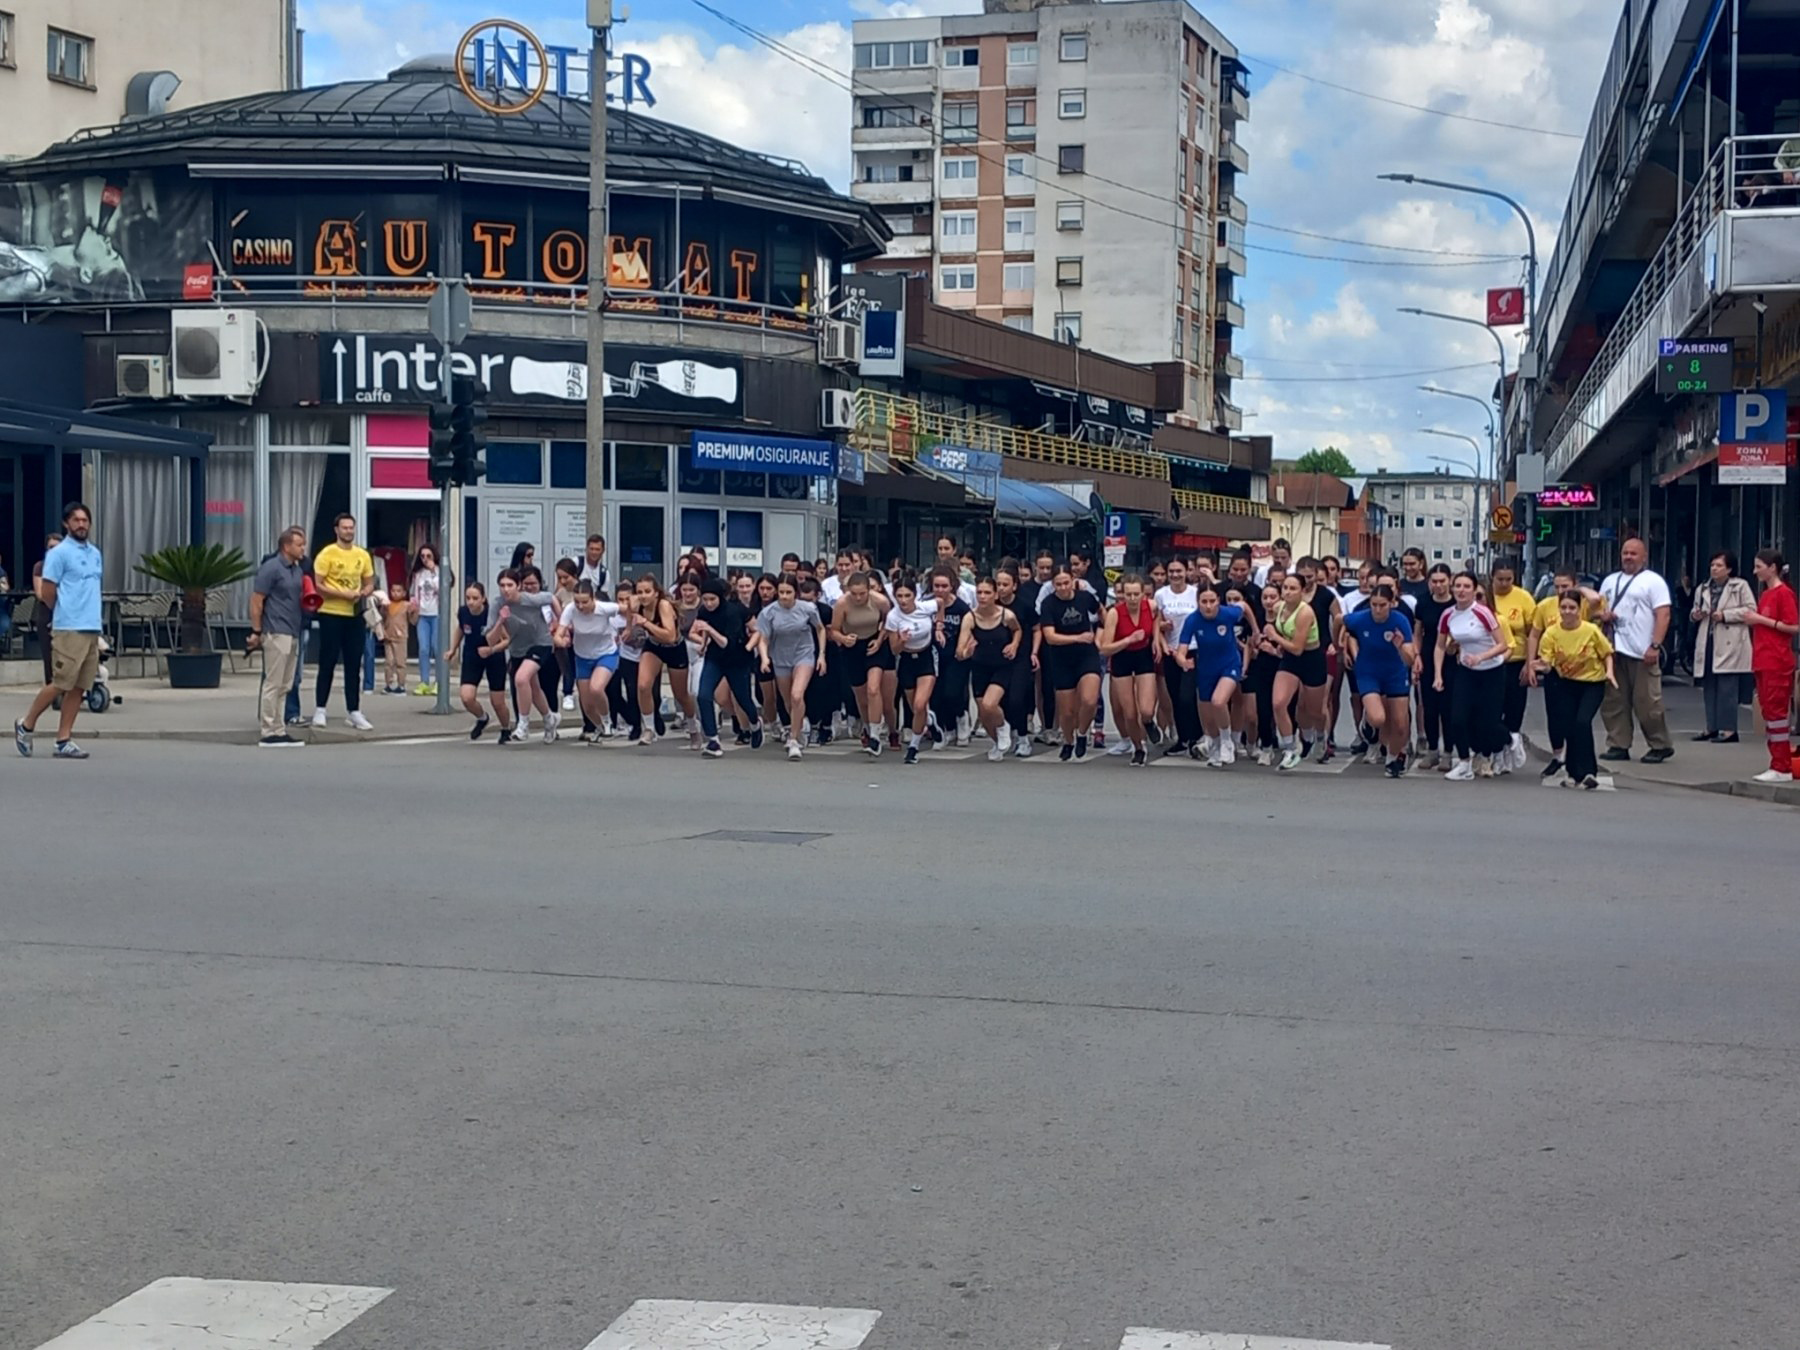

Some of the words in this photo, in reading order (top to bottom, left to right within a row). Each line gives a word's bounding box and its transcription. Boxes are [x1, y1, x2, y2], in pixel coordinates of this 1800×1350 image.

[232, 238, 293, 266] CASINO
[1675, 343, 1728, 354] PARKING
[1689, 359, 1701, 374] 8
[1677, 380, 1708, 391] 00-24
[355, 388, 392, 403] caffe
[1735, 393, 1771, 441] P
[697, 441, 755, 461] PREMIUM
[755, 446, 830, 467] OSIGURANJE
[1109, 515, 1122, 537] P
